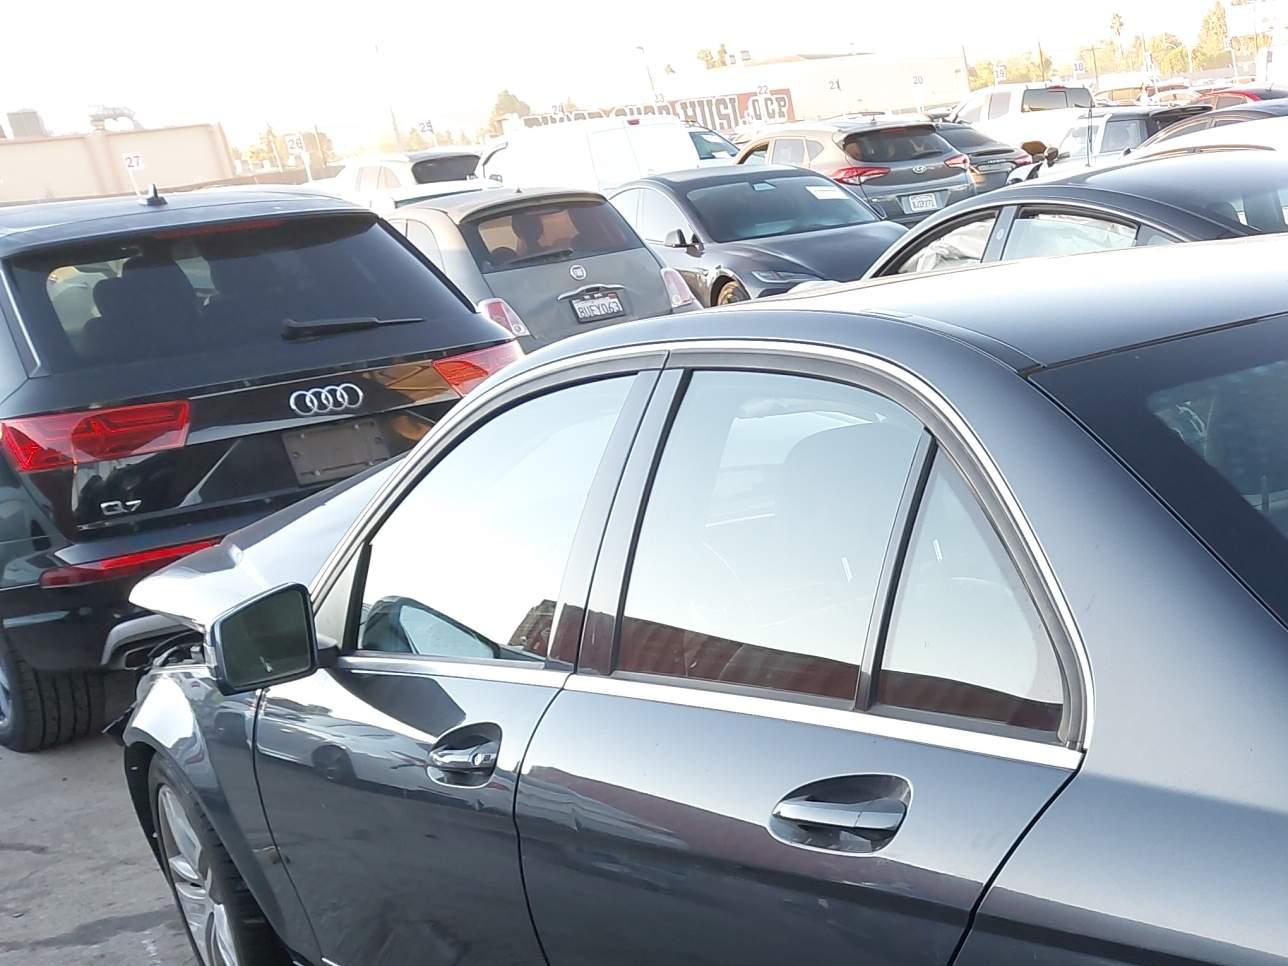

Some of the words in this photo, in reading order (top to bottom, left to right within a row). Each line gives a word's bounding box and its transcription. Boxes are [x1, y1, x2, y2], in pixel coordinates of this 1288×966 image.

[758, 85, 769, 95] 22
[125, 155, 140, 168] 27
[100, 499, 142, 516] Q7
